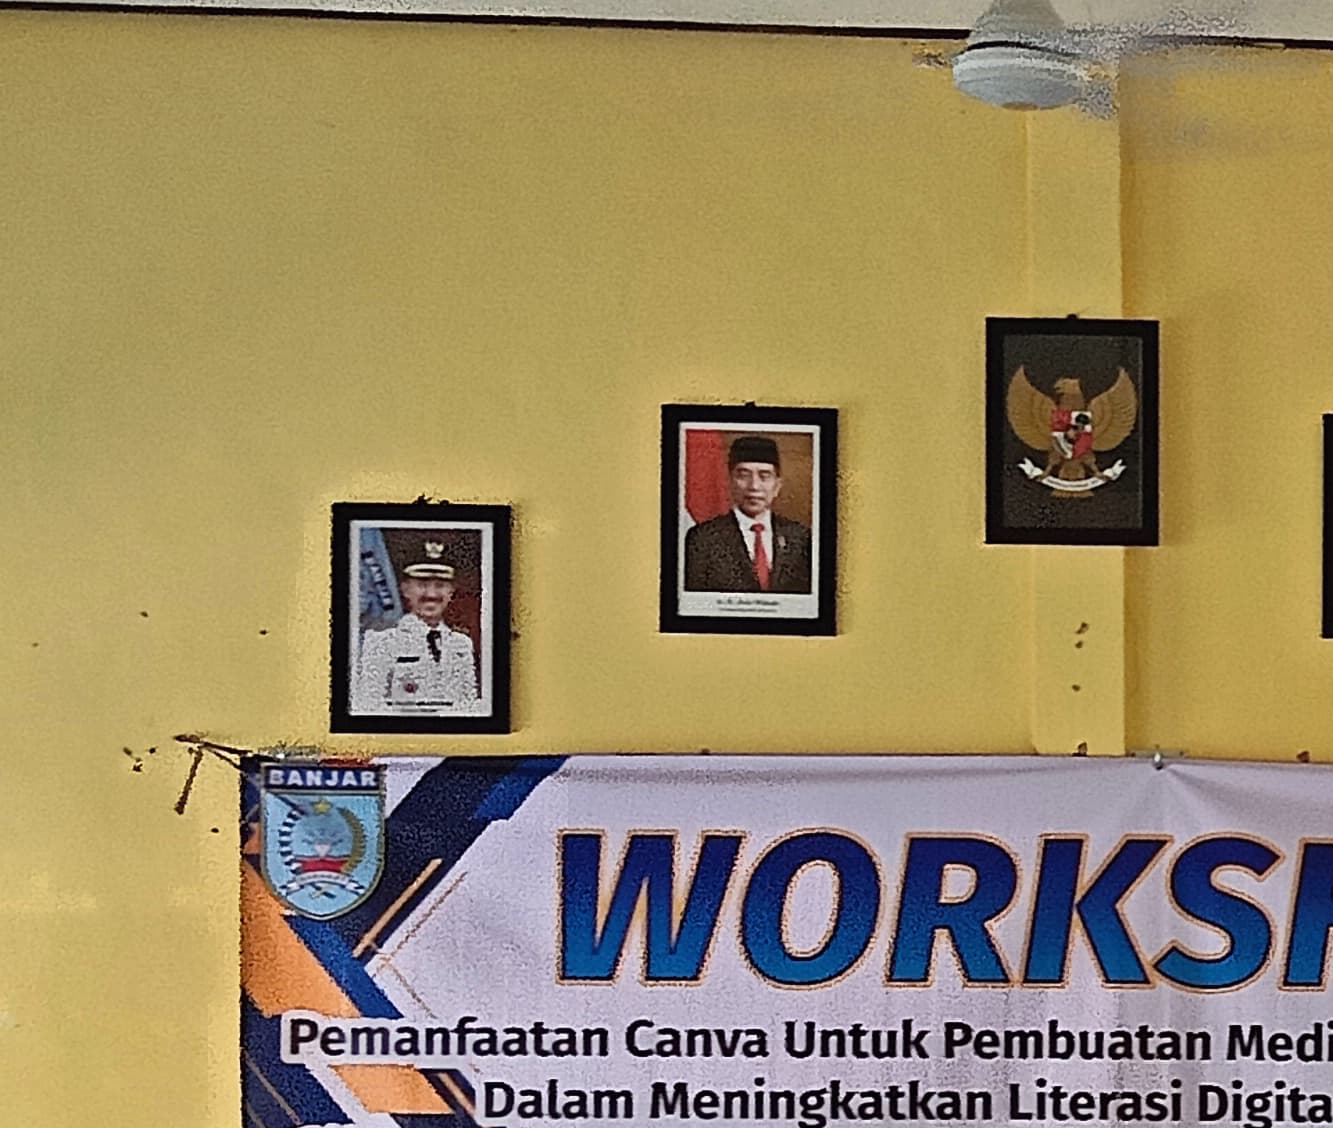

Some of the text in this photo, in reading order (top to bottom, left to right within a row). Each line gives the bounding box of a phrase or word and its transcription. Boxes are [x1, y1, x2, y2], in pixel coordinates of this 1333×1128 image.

[267, 768, 378, 788] BANJAR
[288, 1017, 609, 1060] Pemanfaatan
[625, 1019, 769, 1060] Canva
[784, 1018, 930, 1060] Untuk
[943, 1019, 1212, 1062] Pembuatan
[483, 1078, 634, 1120] Dalam
[1008, 1079, 1183, 1122] Literasi
